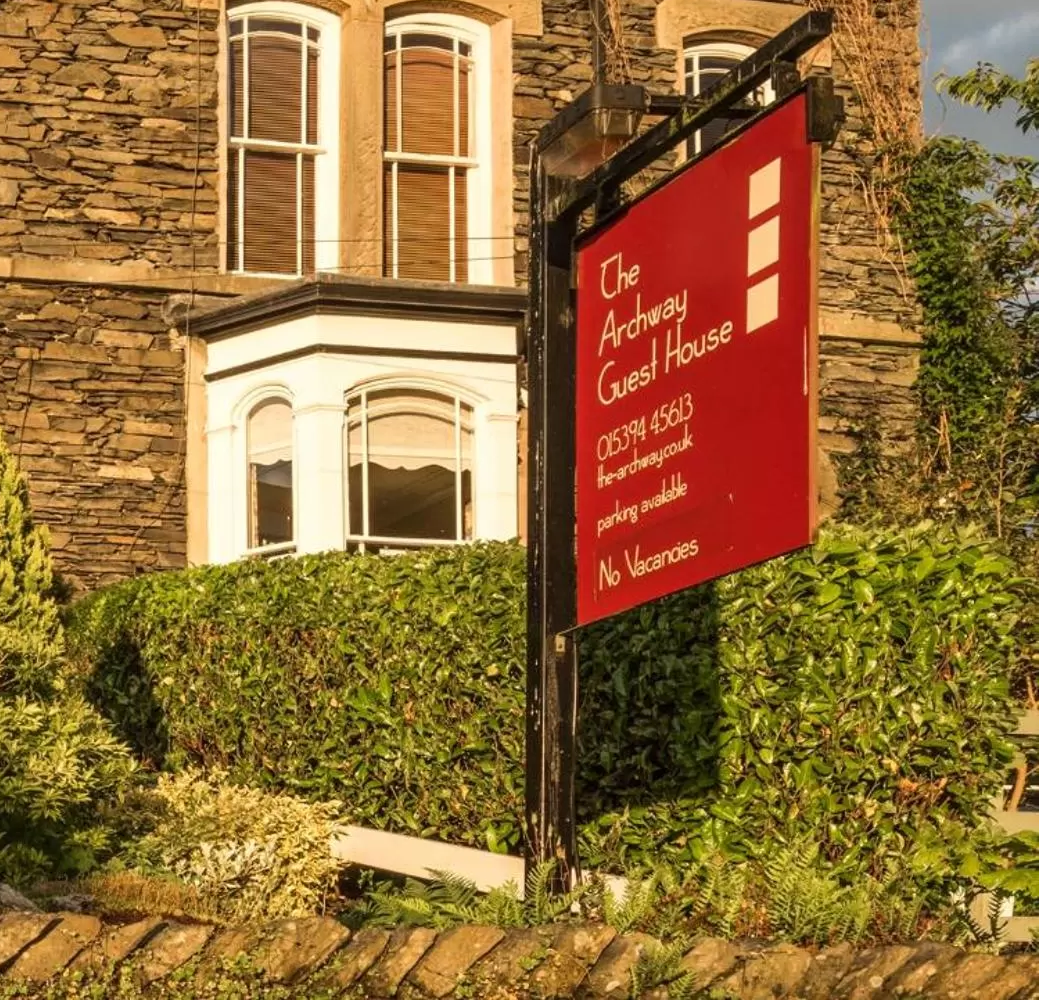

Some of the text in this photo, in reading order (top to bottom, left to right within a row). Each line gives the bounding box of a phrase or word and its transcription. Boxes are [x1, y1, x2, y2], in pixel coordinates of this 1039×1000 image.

[600, 252, 640, 299] The
[598, 289, 688, 357] Archway
[597, 321, 734, 405] Guest House
[597, 392, 694, 461] 015394 45613
[597, 471, 688, 538] parking available
[599, 539, 699, 591] No Vacancies
